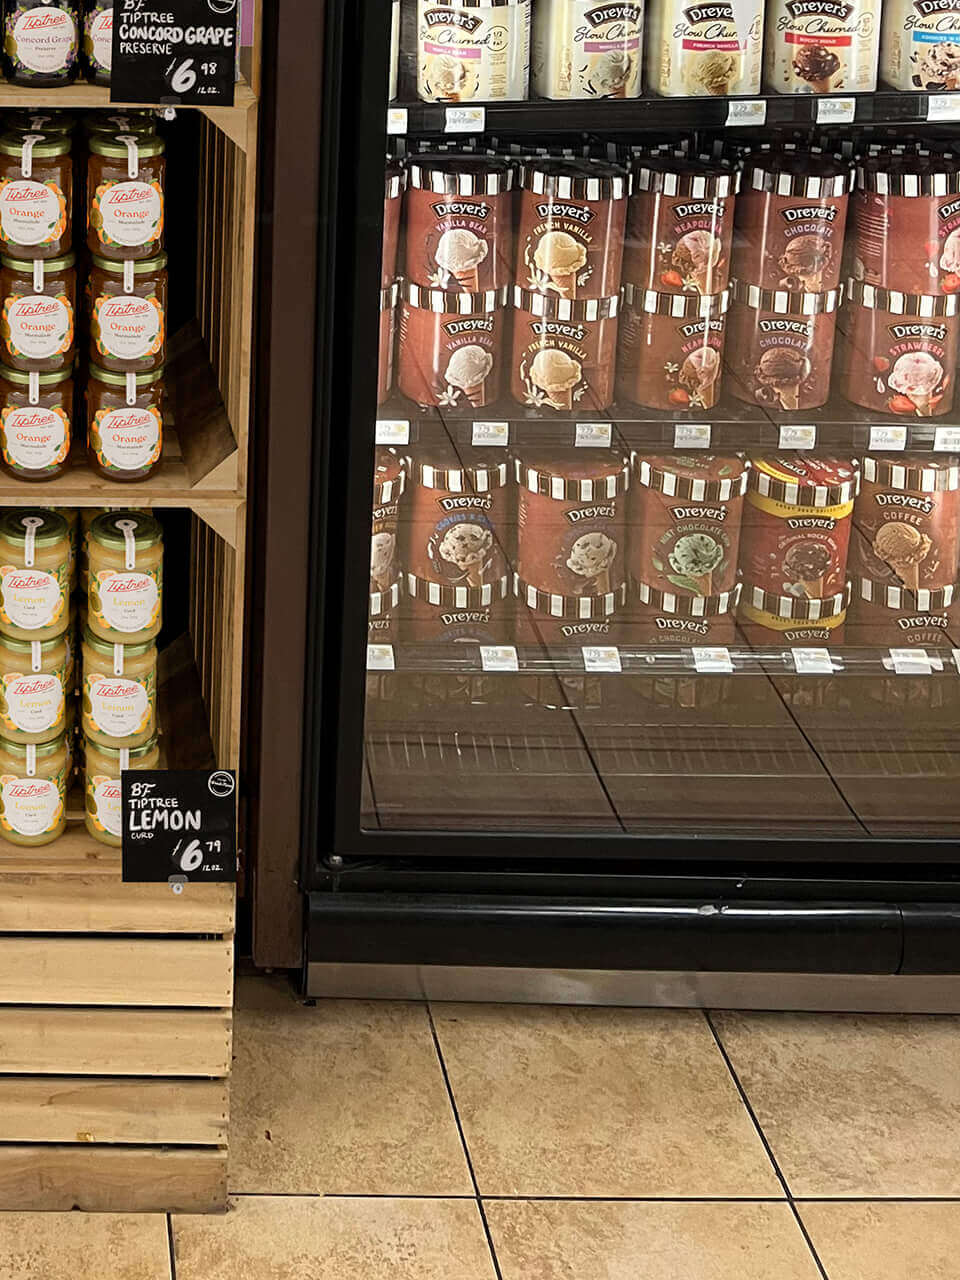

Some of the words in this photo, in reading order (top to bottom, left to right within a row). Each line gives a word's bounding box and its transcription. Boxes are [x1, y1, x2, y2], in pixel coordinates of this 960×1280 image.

[119, 12, 175, 24] TIPTREE
[119, 24, 183, 43] CONCORD
[184, 26, 234, 47] GRAPE
[119, 42, 173, 55] PRESERVE
[436, 202, 488, 218] Dreyer's
[785, 206, 836, 222] Dreyer's
[783, 223, 834, 237] CHOCOLATE
[893, 324, 948, 340] Dreyer's
[876, 493, 934, 513] Dreyer's
[673, 505, 728, 522] Dreyer's
[883, 511, 923, 526] COFFEE
[128, 798, 179, 809] TIPTREE
[129, 809, 202, 832] LEMON
[131, 831, 154, 840] CURD
